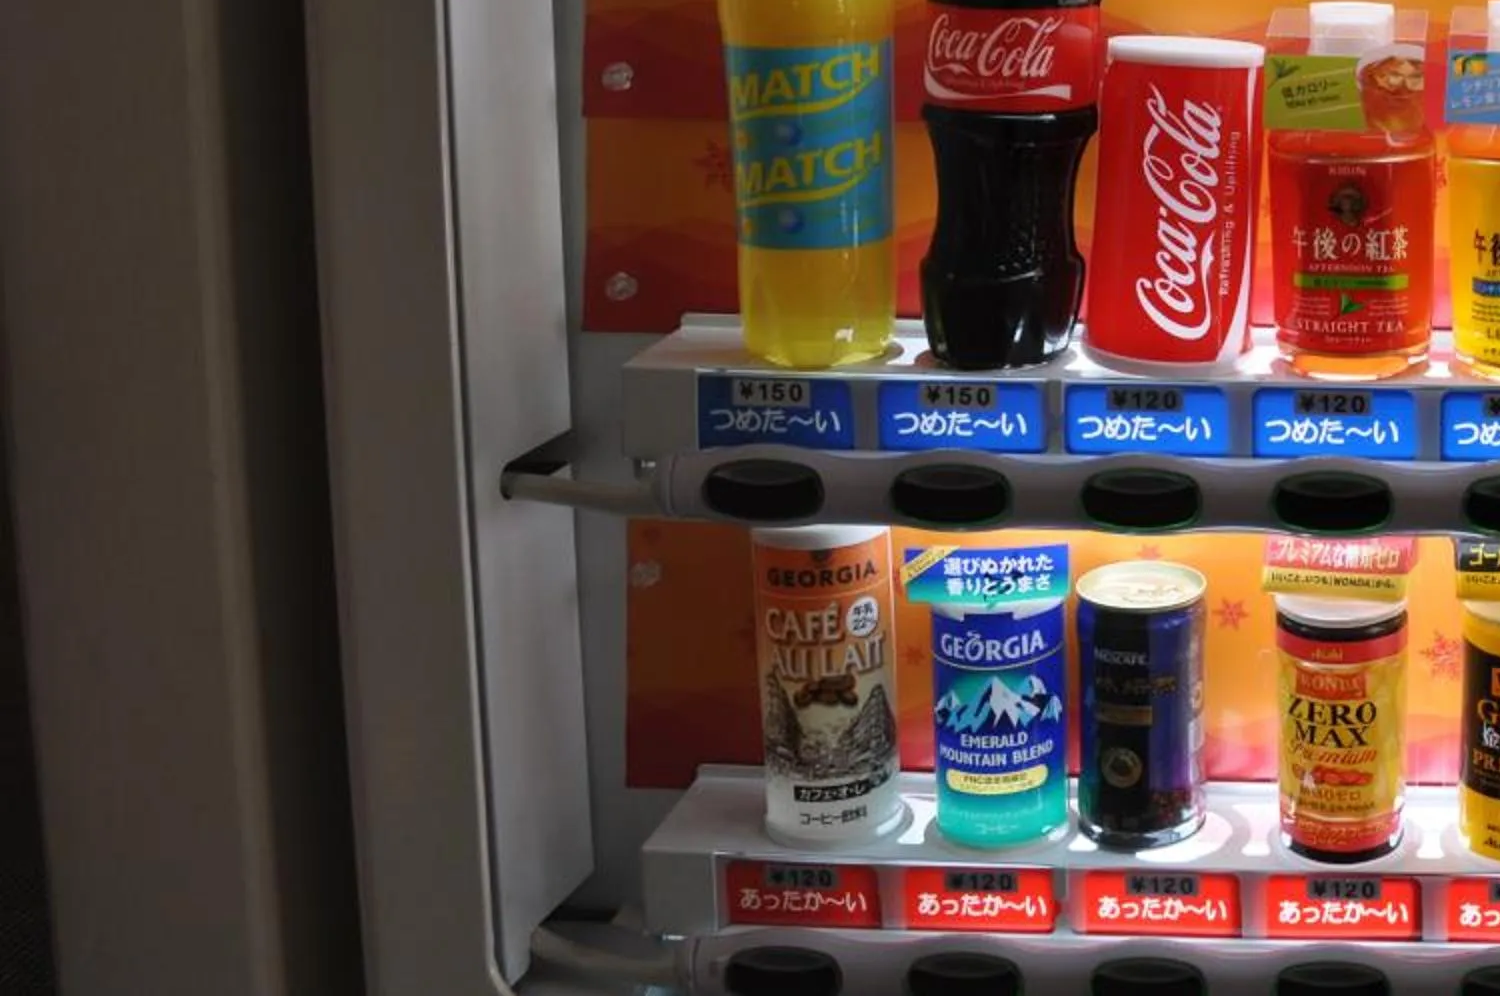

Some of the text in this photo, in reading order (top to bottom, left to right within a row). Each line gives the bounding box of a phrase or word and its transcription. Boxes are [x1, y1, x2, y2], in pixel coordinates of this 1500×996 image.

[926, 12, 1064, 79] Coca-Cola
[732, 44, 882, 104] MATCH
[737, 134, 882, 194] MATCH
[1136, 81, 1222, 341] Coca-Cola
[1292, 225, 1408, 261] 午後の紅茶
[739, 383, 803, 403] ¥150
[926, 385, 990, 406] ¥150
[1111, 390, 1178, 411] ¥120
[1301, 394, 1367, 415] ¥120
[709, 407, 842, 433] つめた〜い
[894, 410, 1028, 437] つめた〜い
[1077, 414, 1212, 441] つめた〜い
[1265, 417, 1400, 444] つめた〜い
[767, 560, 877, 587] GEORGIA
[944, 554, 1054, 576] 選びぬかれた
[946, 573, 1051, 595] 香りとうまさ
[940, 629, 1045, 662] GEORGIA
[1287, 694, 1377, 726] ZERO
[960, 731, 1029, 749] EMERALD
[1294, 719, 1369, 749] MAX
[939, 739, 1054, 767] MOUNTAIN BLEND
[769, 868, 833, 887] ¥120
[949, 872, 1014, 891] ¥120
[1129, 877, 1195, 896] ¥120
[1313, 879, 1377, 899] ¥120
[740, 887, 868, 913] あったか〜い
[917, 893, 1048, 919] あったか〜い
[1097, 896, 1228, 922] あったか〜い
[1278, 900, 1409, 925] あったか〜い
